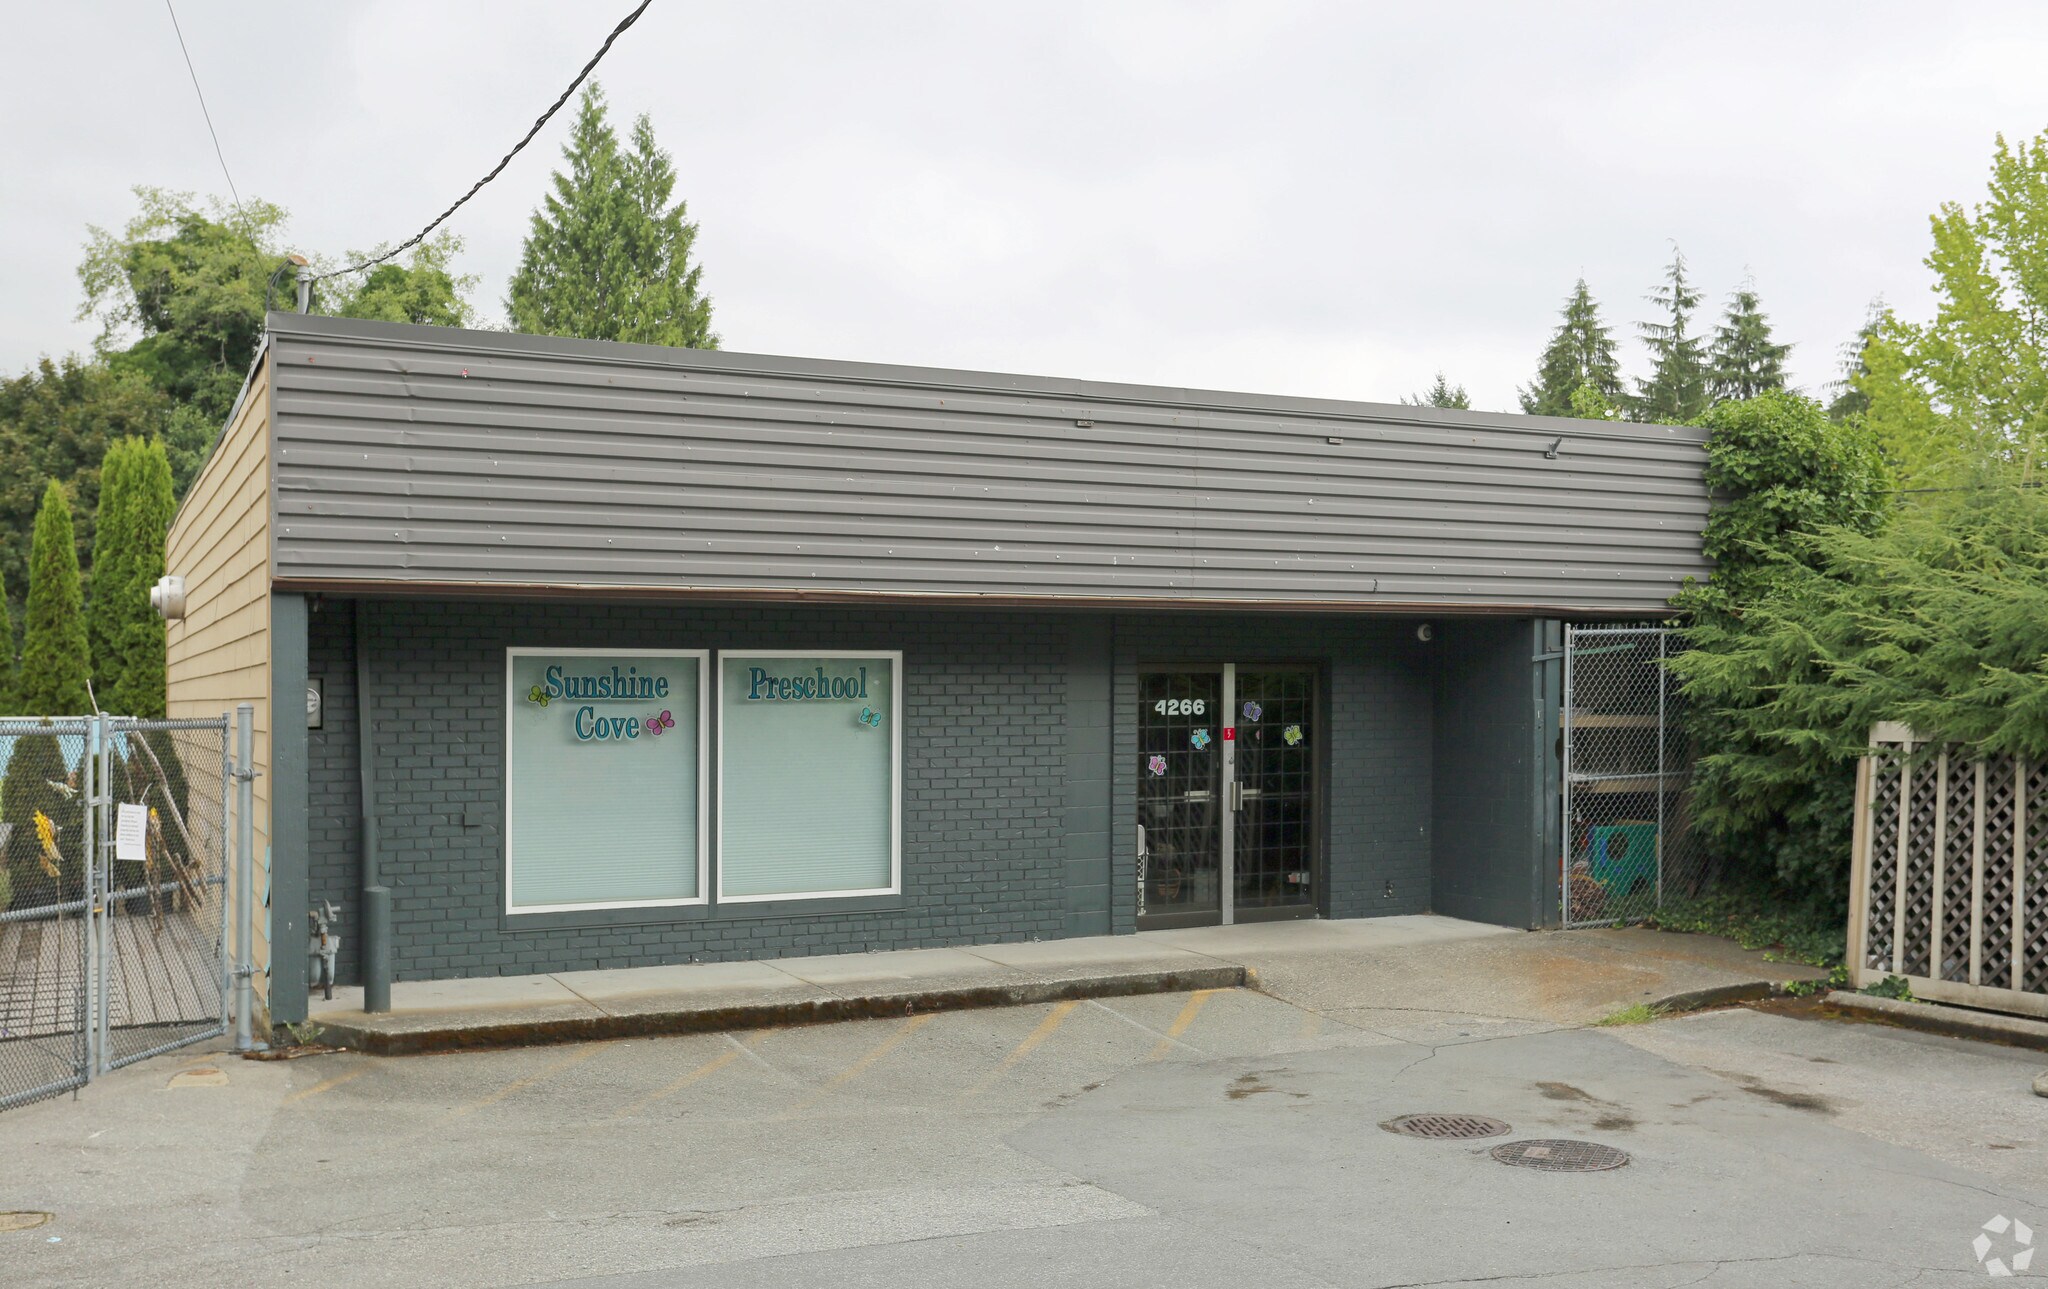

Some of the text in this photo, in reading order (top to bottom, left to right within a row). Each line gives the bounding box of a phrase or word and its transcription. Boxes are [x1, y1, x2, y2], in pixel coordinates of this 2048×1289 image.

[545, 665, 669, 699] Sunshine
[748, 666, 868, 700] Preschool
[575, 705, 640, 740] Cove
[1154, 698, 1205, 716] 4266
